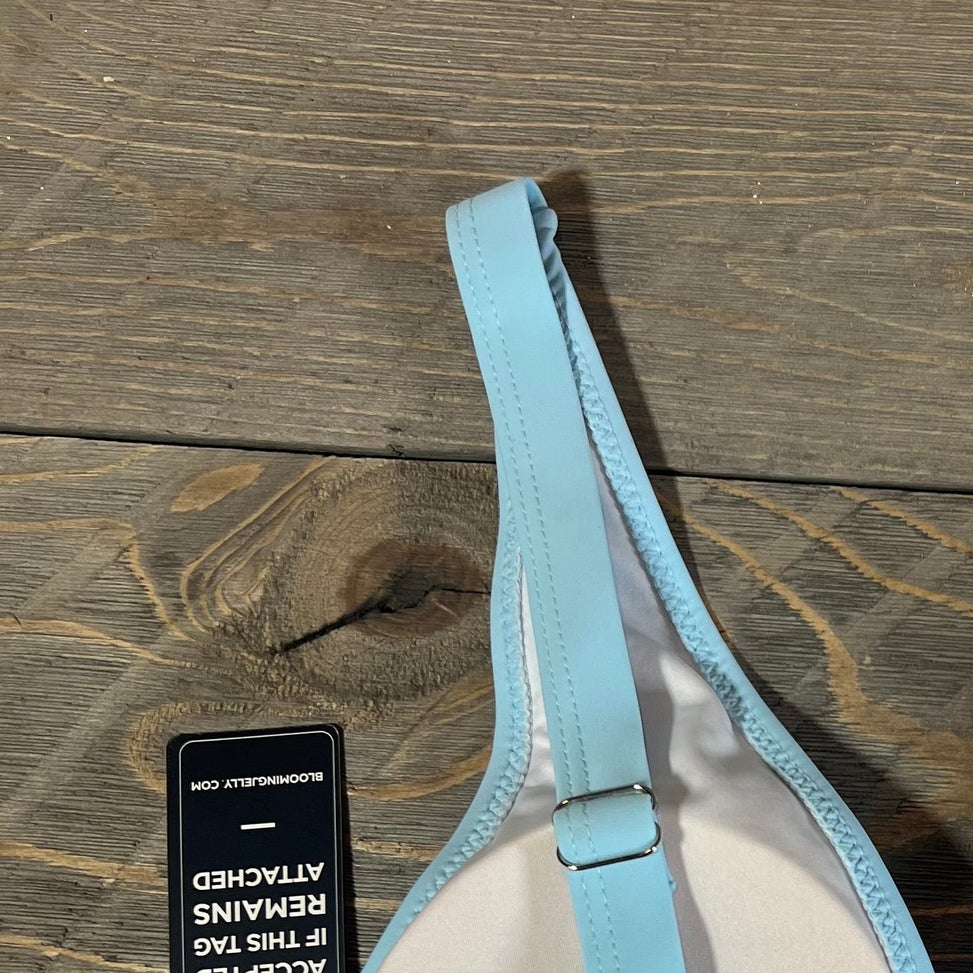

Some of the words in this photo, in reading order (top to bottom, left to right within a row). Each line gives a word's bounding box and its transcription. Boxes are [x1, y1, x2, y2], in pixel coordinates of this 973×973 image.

[192, 862, 325, 891] ATTACHED
[193, 893, 327, 926] REMAINS
[193, 935, 242, 957] TAG
[246, 930, 301, 952] THIS
[304, 927, 327, 947] IF
